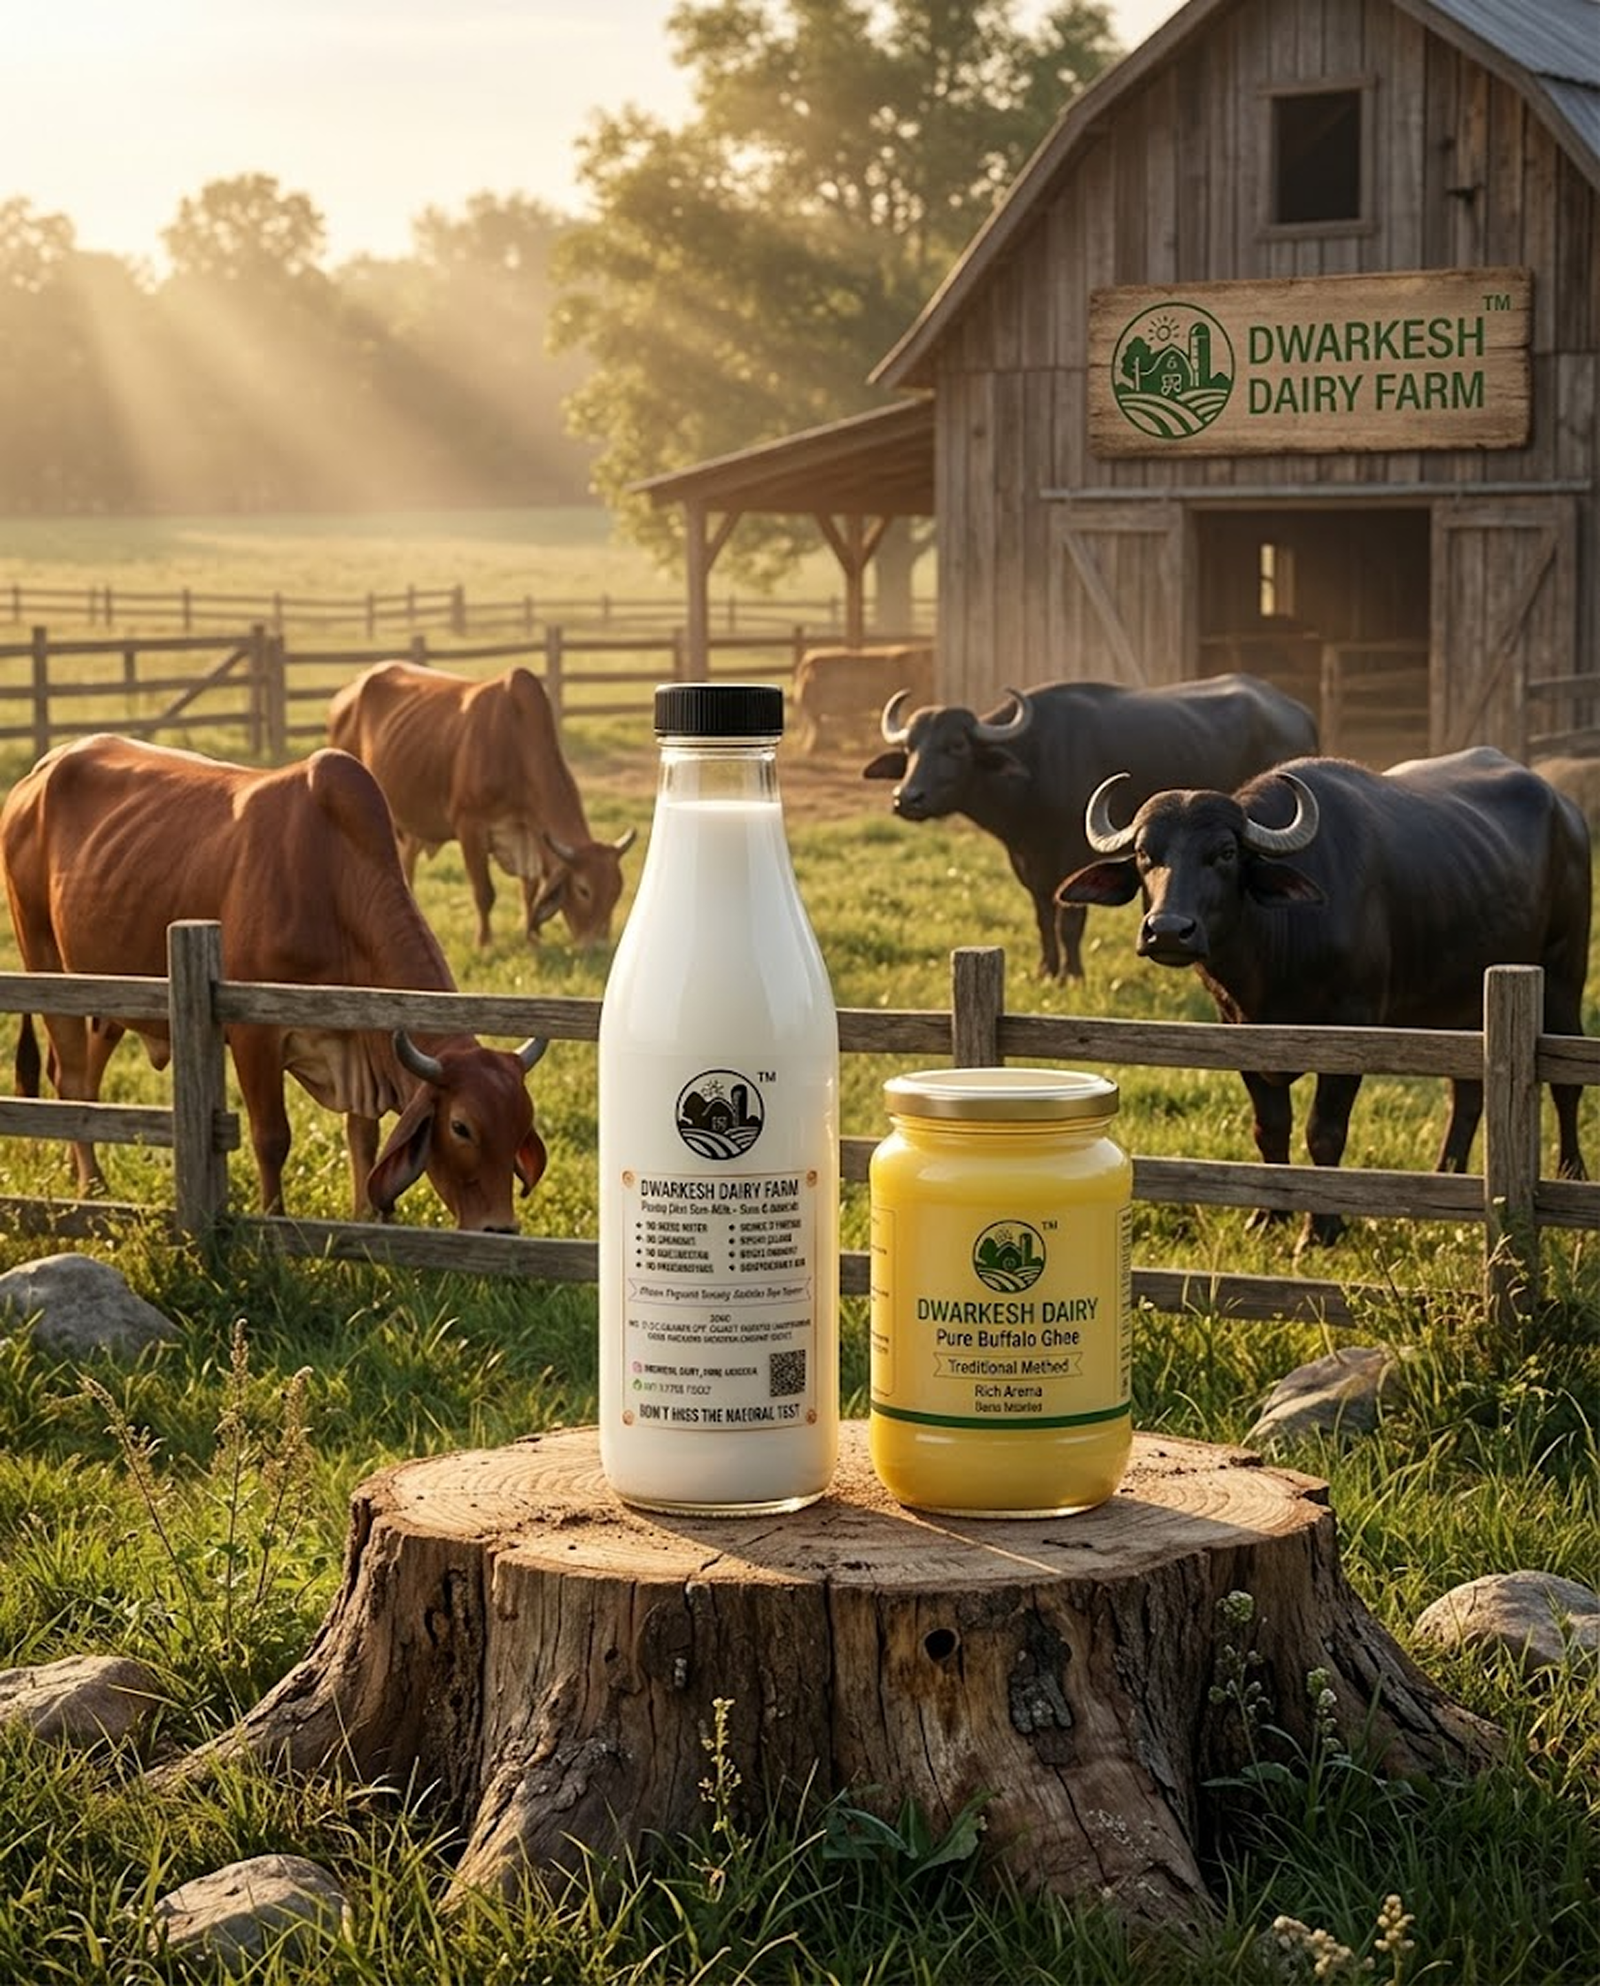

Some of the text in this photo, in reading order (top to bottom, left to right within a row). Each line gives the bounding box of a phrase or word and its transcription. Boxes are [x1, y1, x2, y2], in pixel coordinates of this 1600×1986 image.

[1482, 294, 1510, 311] TM
[1249, 317, 1484, 364] DWARKESH
[1249, 371, 1484, 414] DAIRY FARM
[757, 1071, 776, 1083] TM
[641, 1180, 715, 1200] DWARKESH
[719, 1182, 761, 1200] DAIRY
[918, 1297, 1099, 1324] DWARKESH DAIRY
[936, 1328, 1080, 1348] Pure Buffalo Ghee
[975, 1384, 1001, 1397] Rich
[701, 1408, 723, 1422] THE
[777, 1403, 799, 1419] TEST
